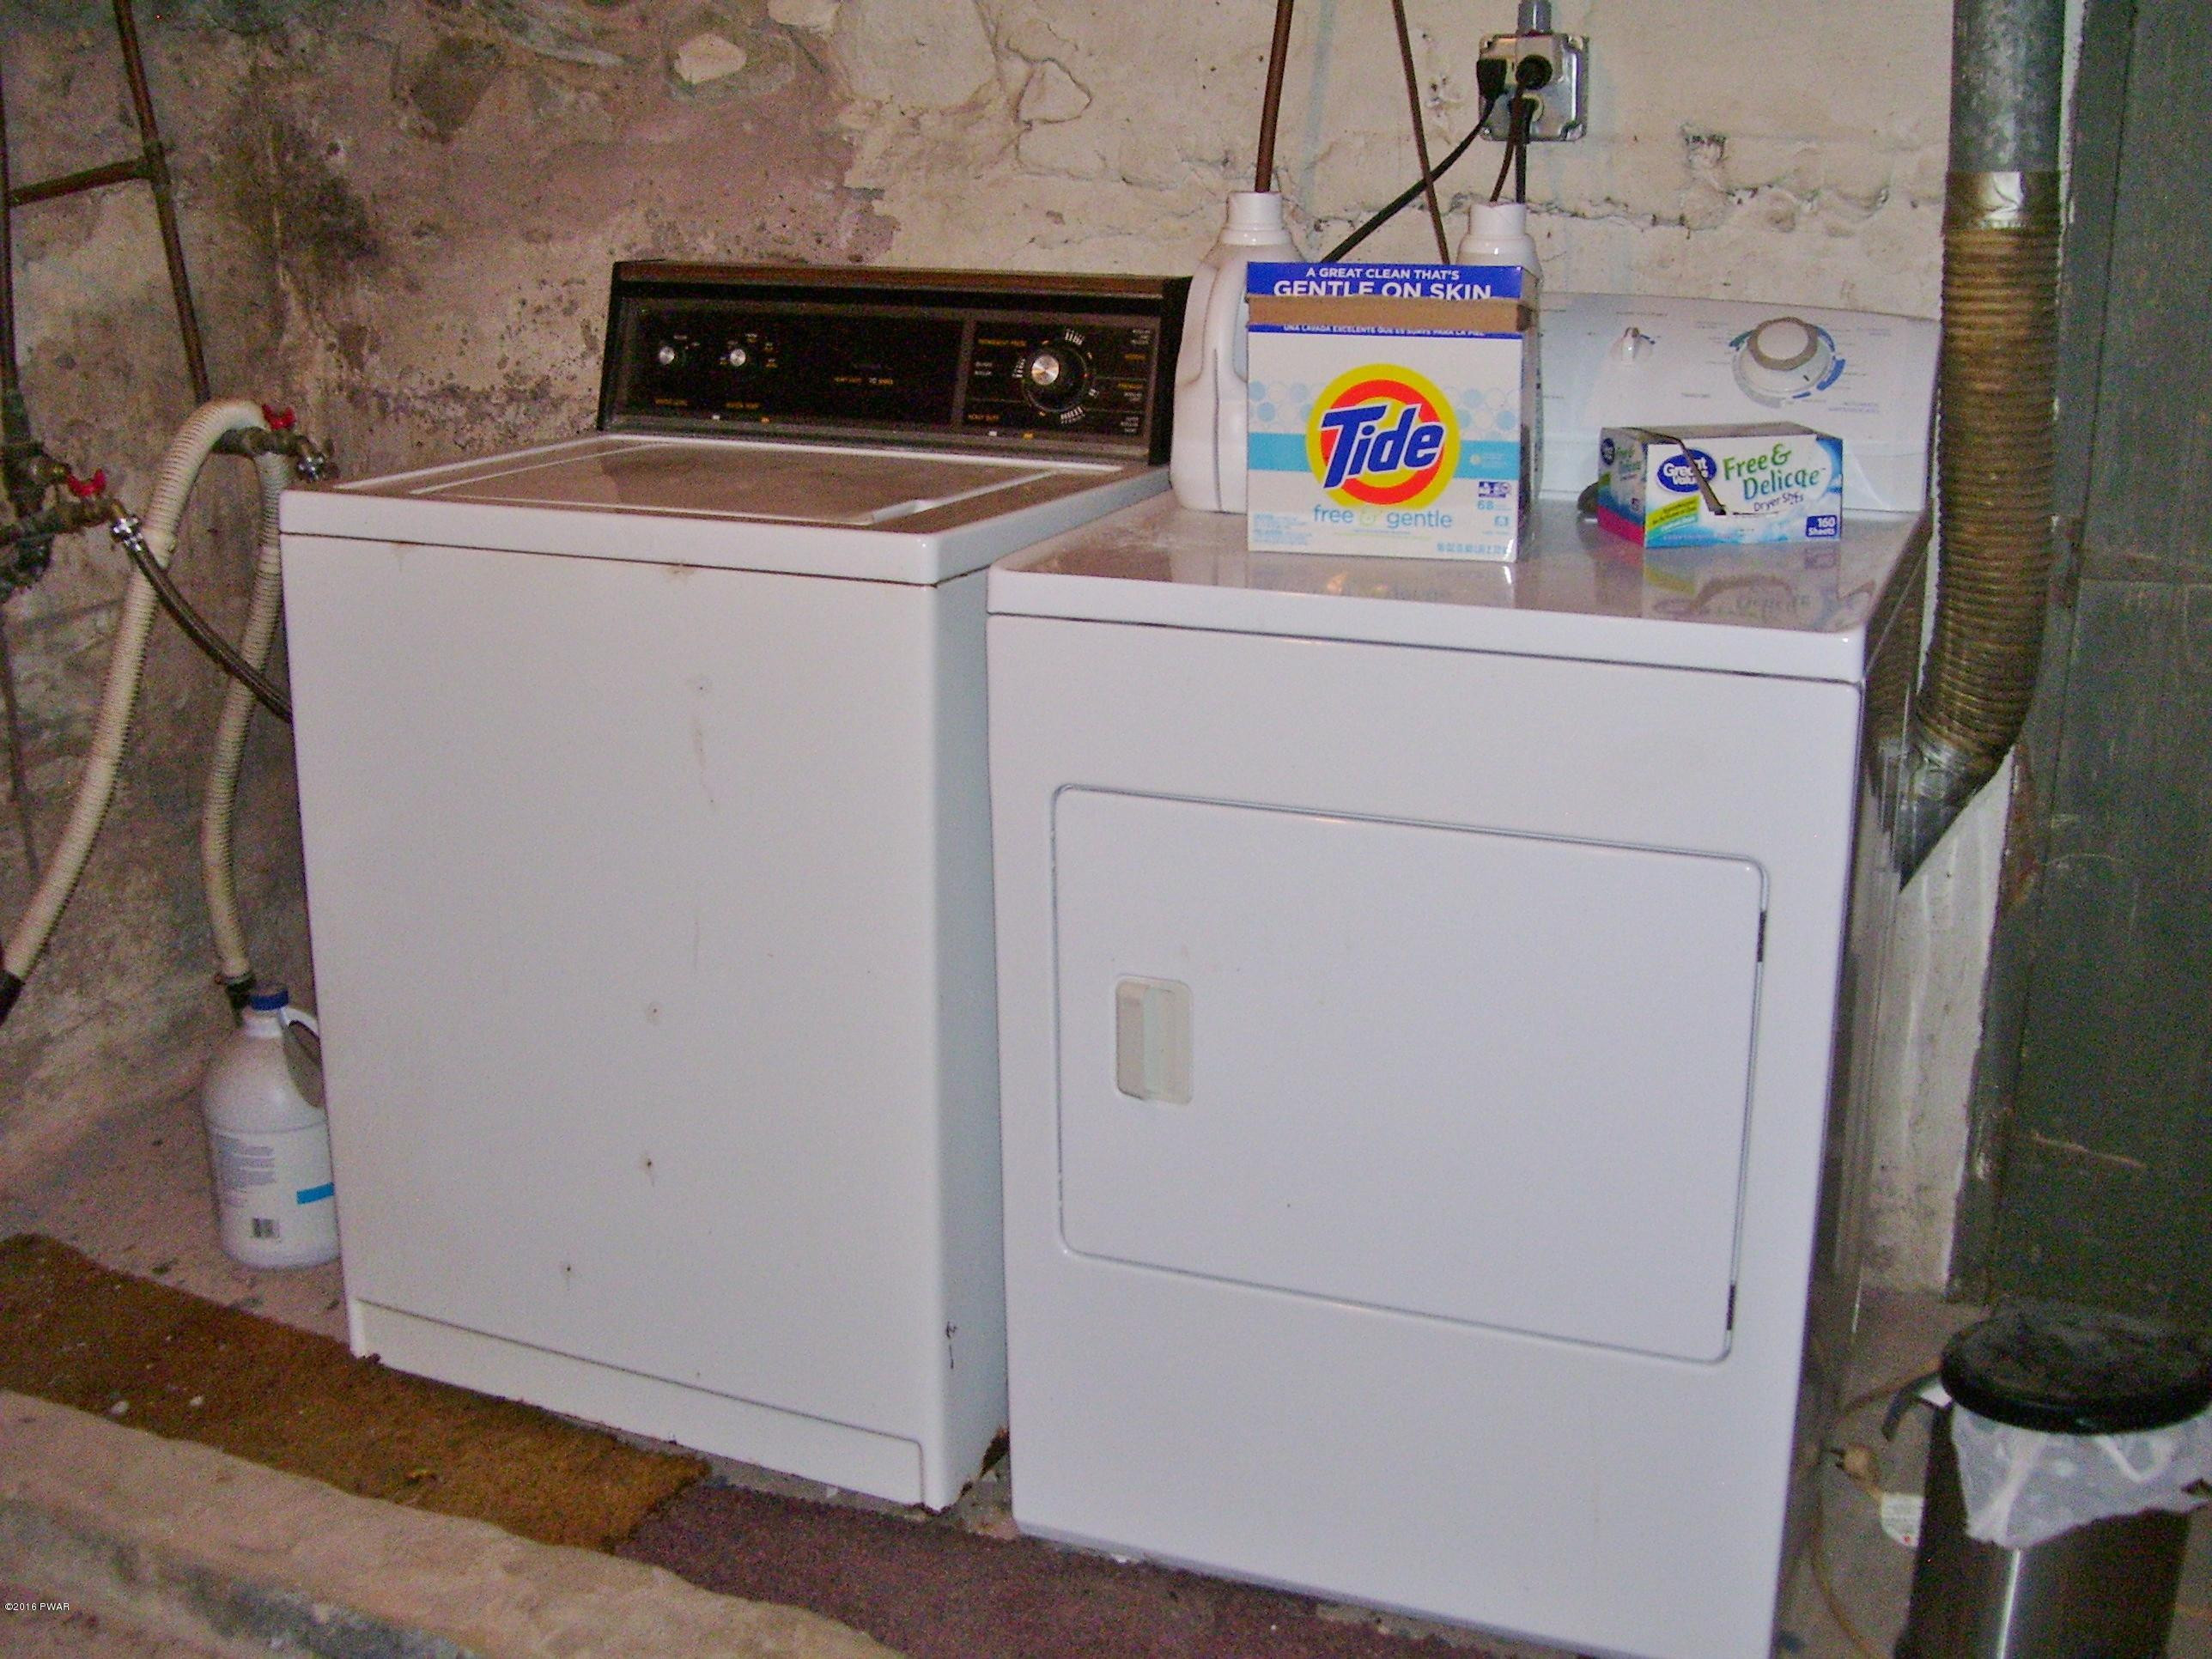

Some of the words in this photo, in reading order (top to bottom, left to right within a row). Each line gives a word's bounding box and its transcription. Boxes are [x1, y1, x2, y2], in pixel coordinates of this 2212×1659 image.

[1306, 268, 1314, 276] A
[1319, 268, 1361, 278] GREAT
[1365, 269, 1410, 279] CLEAN
[1414, 270, 1460, 280] THAT'S
[1273, 281, 1374, 296] GENTLE
[1382, 283, 1421, 298] ON
[1430, 284, 1492, 301] SKIN
[1322, 404, 1446, 489] Tide
[1723, 454, 1768, 482] Free
[1771, 443, 1792, 465] &
[1313, 504, 1354, 524] free
[1387, 510, 1452, 529] gentle
[1818, 517, 1836, 527] 160
